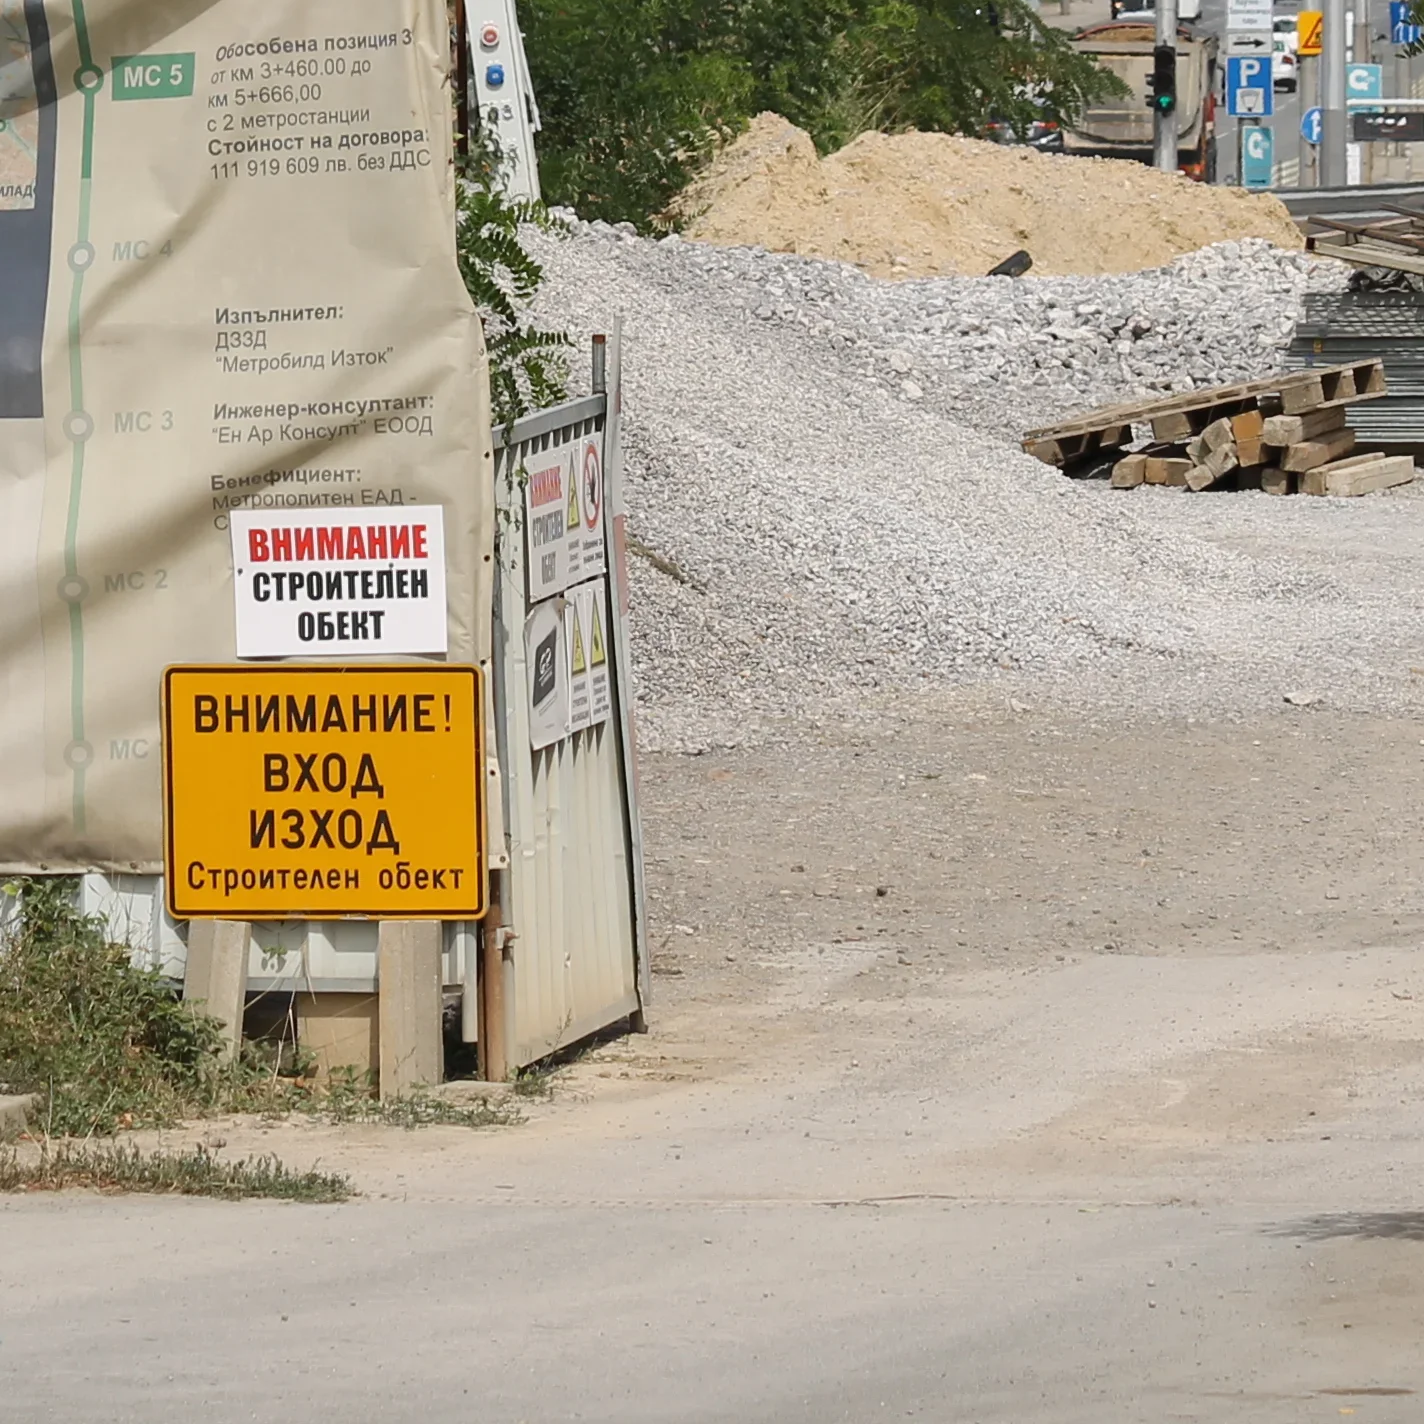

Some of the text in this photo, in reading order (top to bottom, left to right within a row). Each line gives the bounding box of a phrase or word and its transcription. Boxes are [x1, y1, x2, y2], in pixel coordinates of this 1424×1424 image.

[215, 28, 412, 62] Обособена позиция 3
[124, 64, 183, 87] МС 5
[211, 57, 371, 84] от км 3+460.00 до
[208, 84, 322, 108] км 5+666,00
[207, 108, 370, 132] с 2 метростанции
[208, 128, 429, 156] Стойност на договора:
[211, 149, 432, 180] 111 919 609 лв. без ДДС
[112, 240, 173, 262] МС 4
[215, 306, 343, 325] Изпълнител:
[215, 330, 267, 352] ДЗЗД
[214, 395, 434, 420] Инженер-консултант:
[114, 410, 174, 434] МС 3
[247, 425, 273, 446] Ар
[374, 416, 433, 437] ЕООД
[211, 468, 361, 491] Бенефициент:
[212, 491, 354, 511] Метрополитен
[361, 489, 404, 506] ЕАД
[248, 524, 429, 562] ВНИМАНИЕ
[104, 569, 168, 593] МС 2
[252, 568, 429, 602] СТРОИТЕЛЕН
[298, 610, 385, 641] ОБЕКТ
[193, 694, 452, 734] ВНИМАНИЕ!
[110, 739, 149, 760] МС
[264, 753, 385, 799] ВХОД
[250, 808, 400, 855] ИЗХОД
[187, 861, 464, 896] Строителен обект
